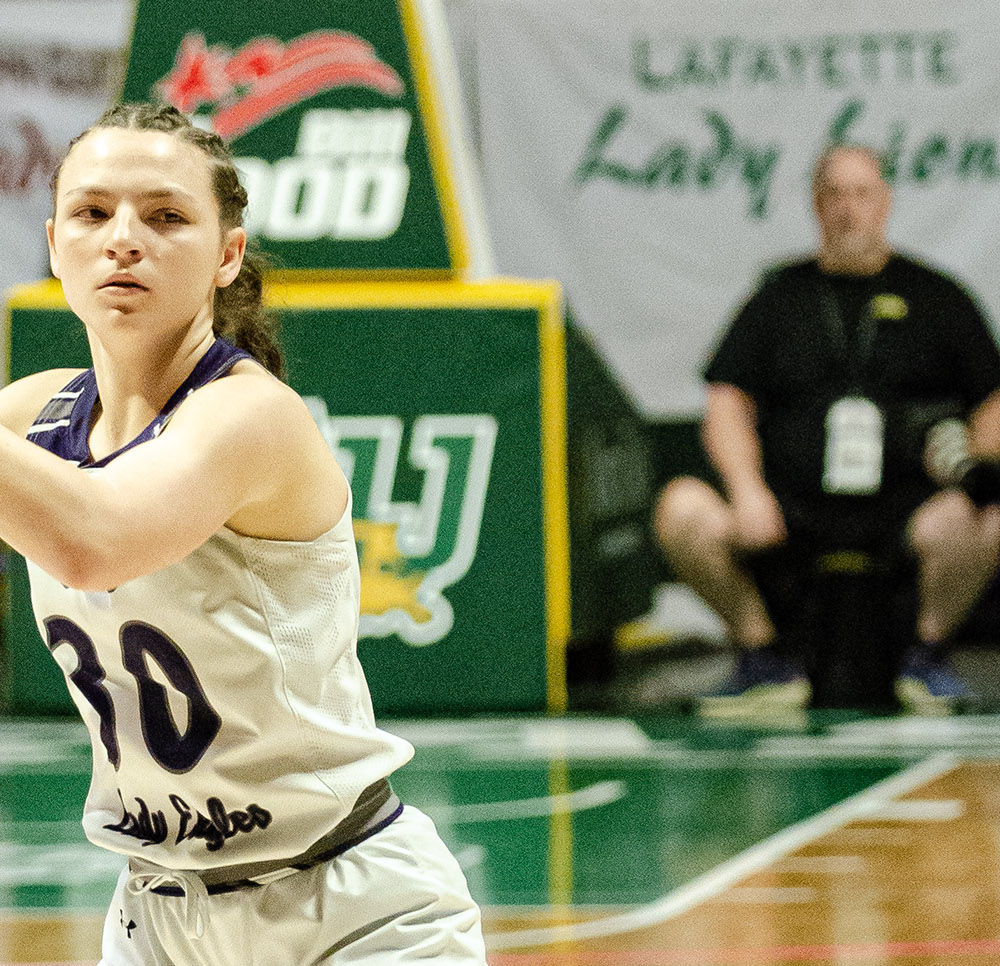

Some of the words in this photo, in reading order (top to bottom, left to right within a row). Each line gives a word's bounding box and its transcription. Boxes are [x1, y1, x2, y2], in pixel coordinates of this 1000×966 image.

[632, 31, 958, 88] LAFAYETTE
[576, 101, 780, 219] Lady
[43, 614, 222, 775] 30
[103, 787, 168, 847] Lady
